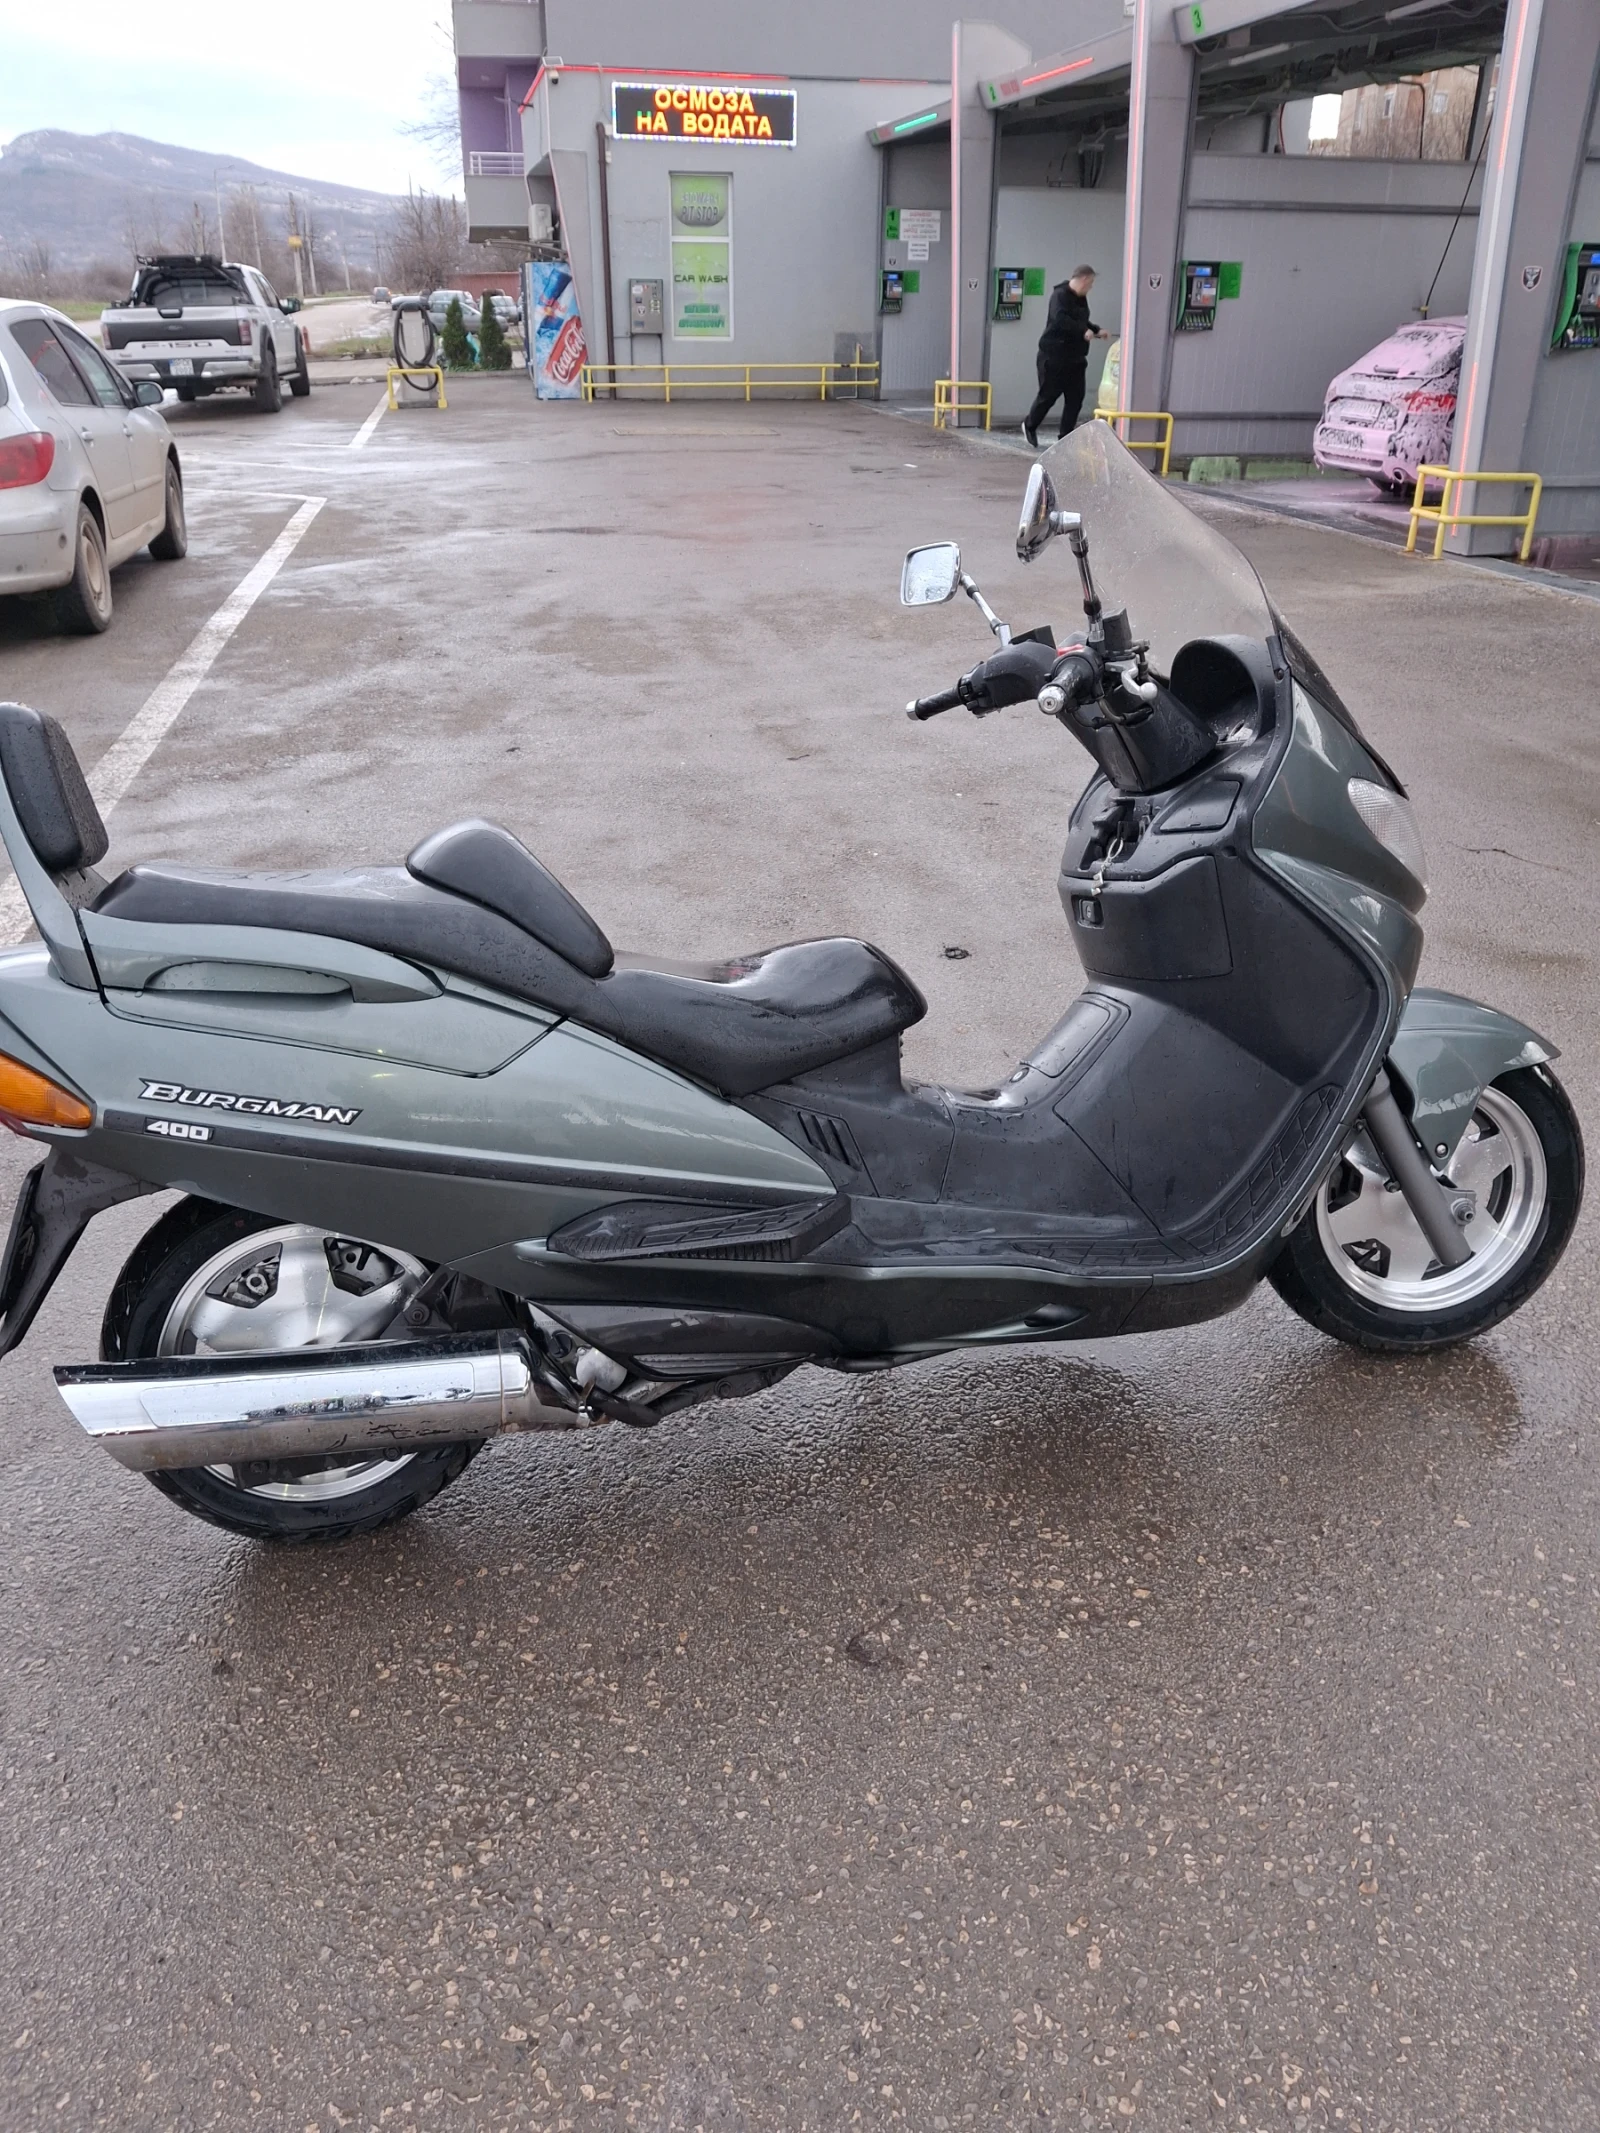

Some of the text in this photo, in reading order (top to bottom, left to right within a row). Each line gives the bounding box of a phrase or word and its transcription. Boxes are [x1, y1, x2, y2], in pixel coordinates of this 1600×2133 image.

[1193, 9, 1202, 28] 3
[654, 88, 754, 113] ОСМОЗА
[636, 110, 773, 138] НА ВОДАТА
[682, 205, 719, 222] PIT STOP
[674, 274, 729, 283] CAR WASH
[141, 340, 213, 349] F-150
[140, 1079, 361, 1125] BURGMAN
[146, 1119, 210, 1141] 400
